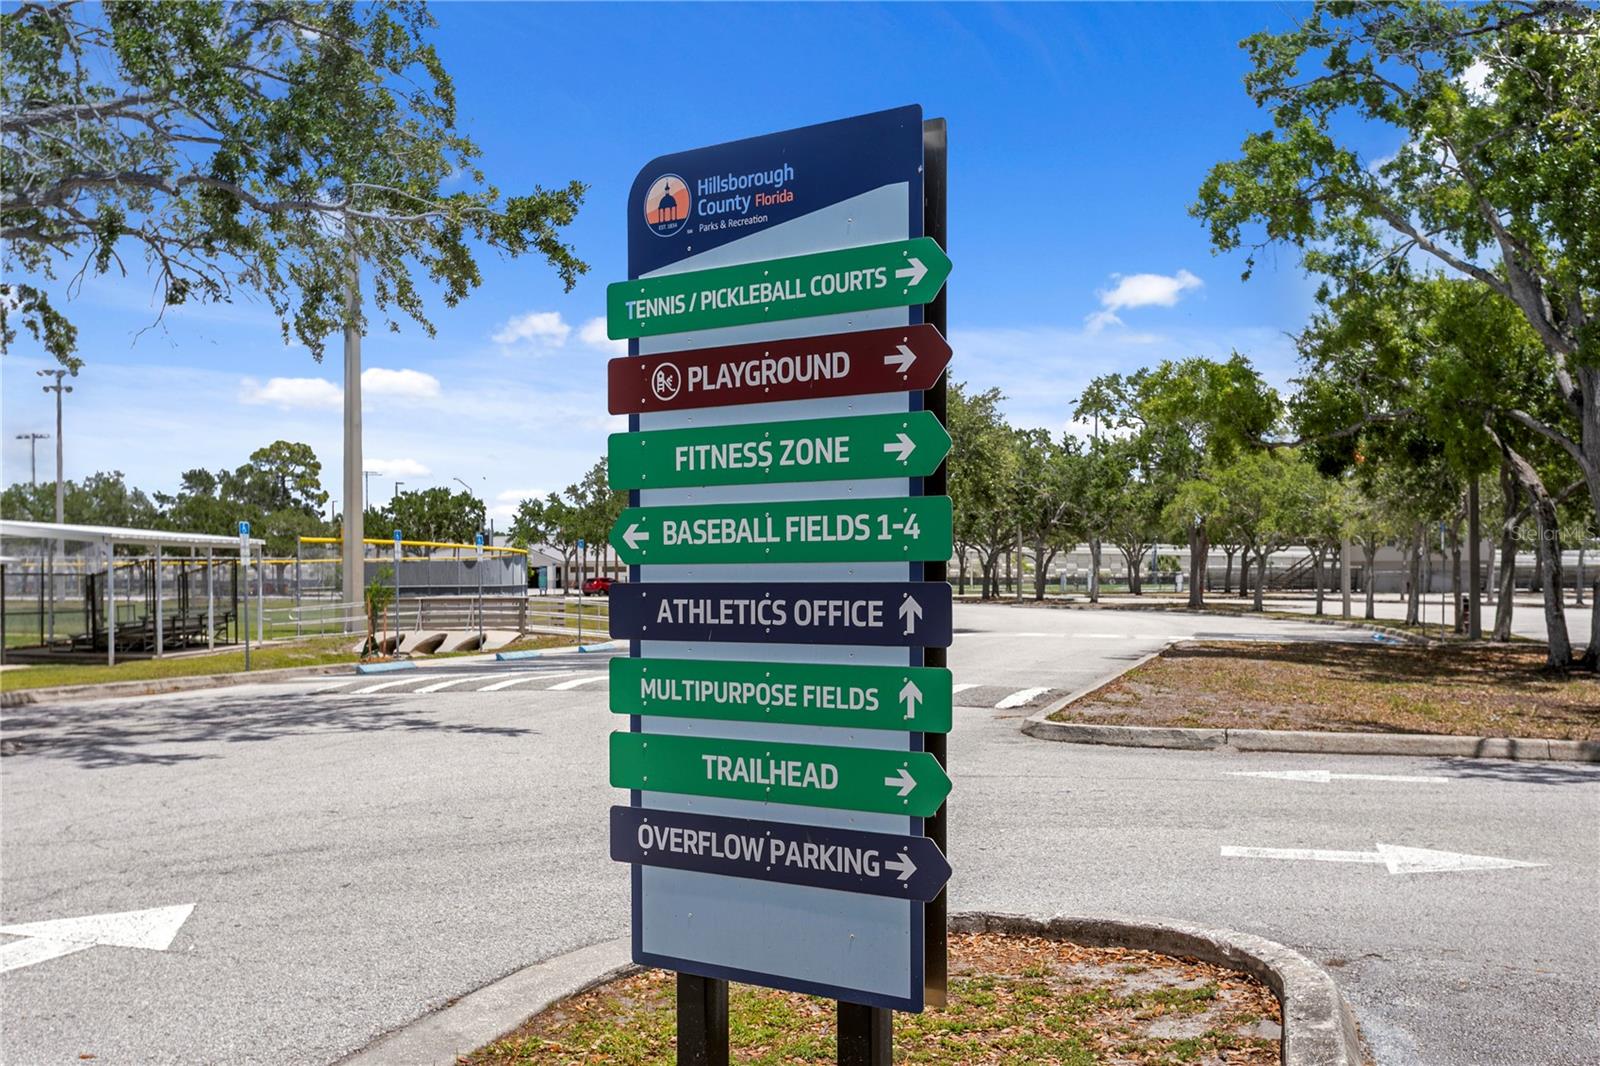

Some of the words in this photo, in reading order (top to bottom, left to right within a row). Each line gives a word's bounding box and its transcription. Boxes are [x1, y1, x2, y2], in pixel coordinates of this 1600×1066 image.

[698, 163, 794, 196] Hillsborough
[697, 194, 751, 216] County
[755, 189, 794, 207] Florida
[699, 221, 719, 232] Parks
[720, 220, 727, 229] &
[728, 214, 768, 227] Recreation
[625, 293, 685, 320] TENNIS
[689, 292, 697, 312] /
[701, 278, 806, 311] PICKLEBALL
[810, 267, 887, 295] COURTS
[688, 351, 850, 392] PLAYGROUND
[675, 441, 773, 472] FITNESS
[779, 436, 850, 466] ZONE
[662, 517, 780, 545] BASEBALL
[785, 513, 870, 542] FIELDS
[877, 513, 921, 541] 1-4
[656, 599, 787, 627] ATHLETICS
[794, 599, 883, 627] OFFICE
[640, 678, 797, 707] MULTIPURPOSE
[803, 685, 879, 711] FIELDS
[702, 754, 839, 790] TRAILHEAD
[637, 823, 764, 863] OVERFLOW
[770, 839, 880, 877] PARKING
